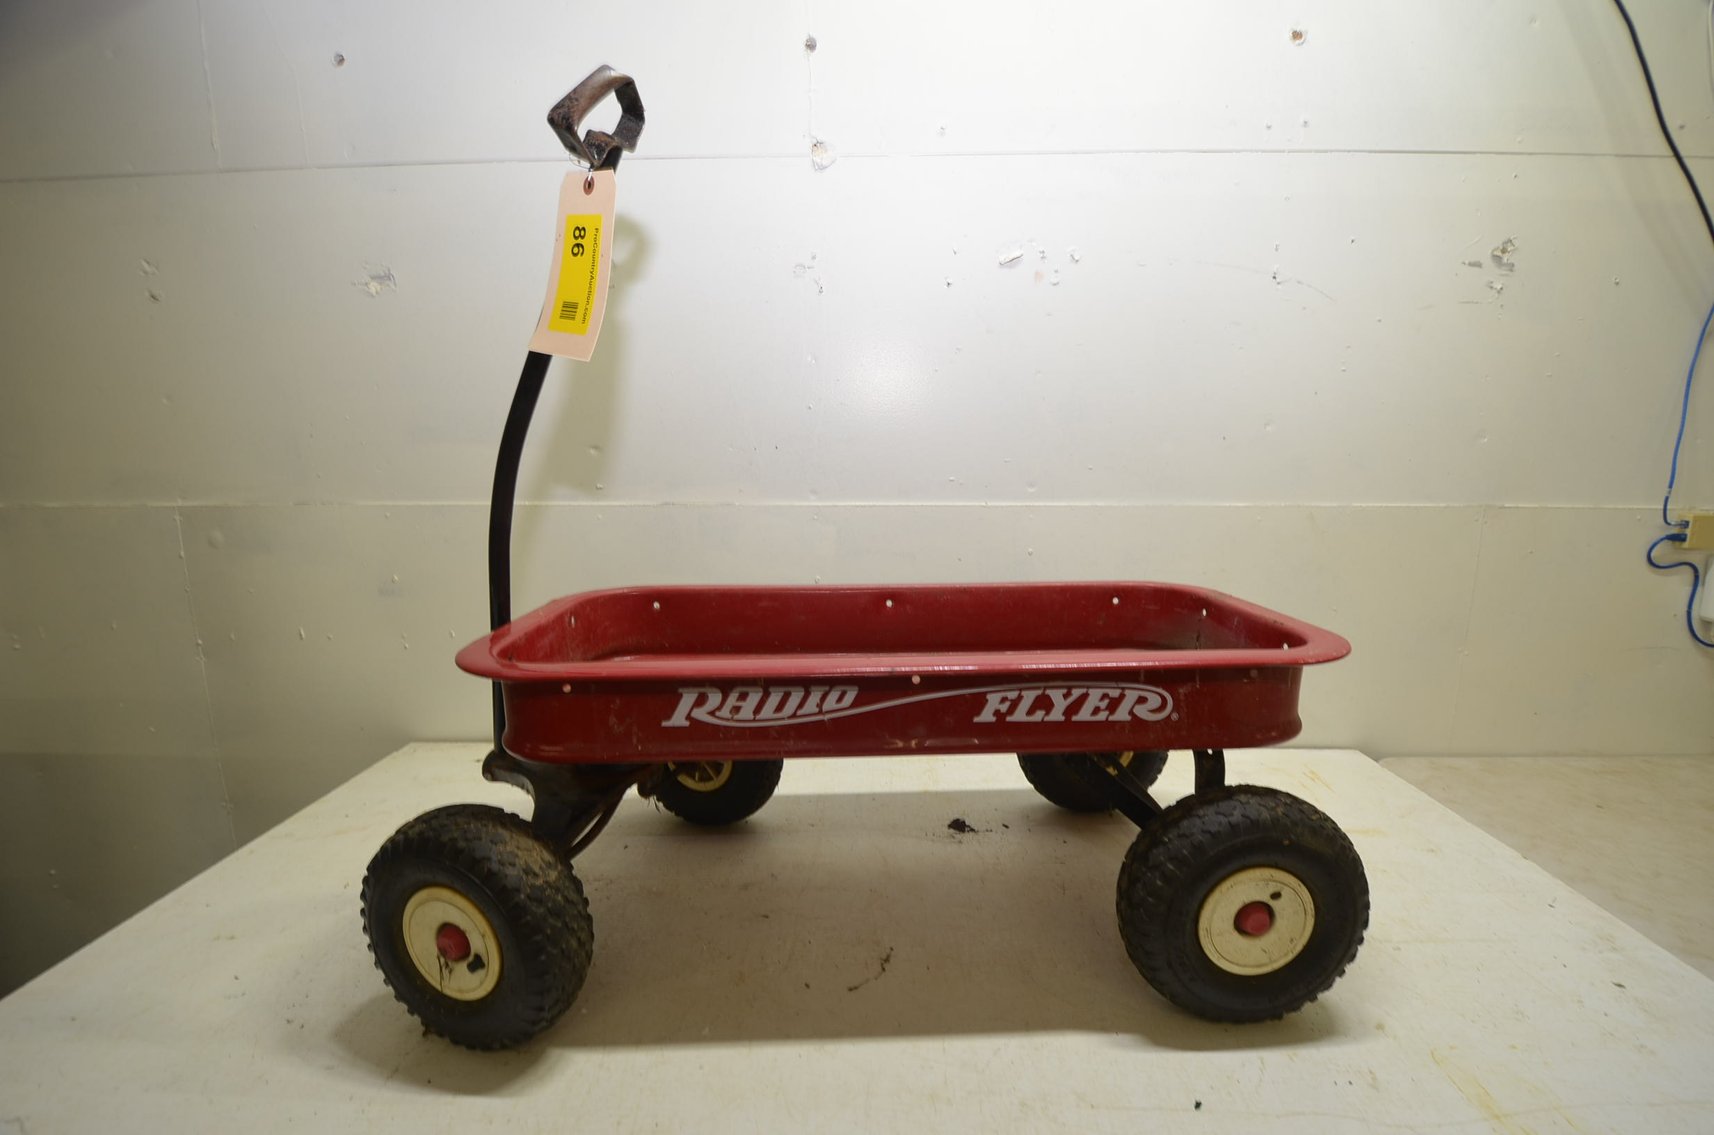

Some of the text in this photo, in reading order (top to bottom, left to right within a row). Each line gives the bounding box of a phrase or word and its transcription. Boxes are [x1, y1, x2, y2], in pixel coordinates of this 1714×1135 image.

[571, 225, 586, 257] 86
[581, 227, 599, 325] ProCountryAuction.com
[661, 684, 1174, 727] RADIO FLYER
